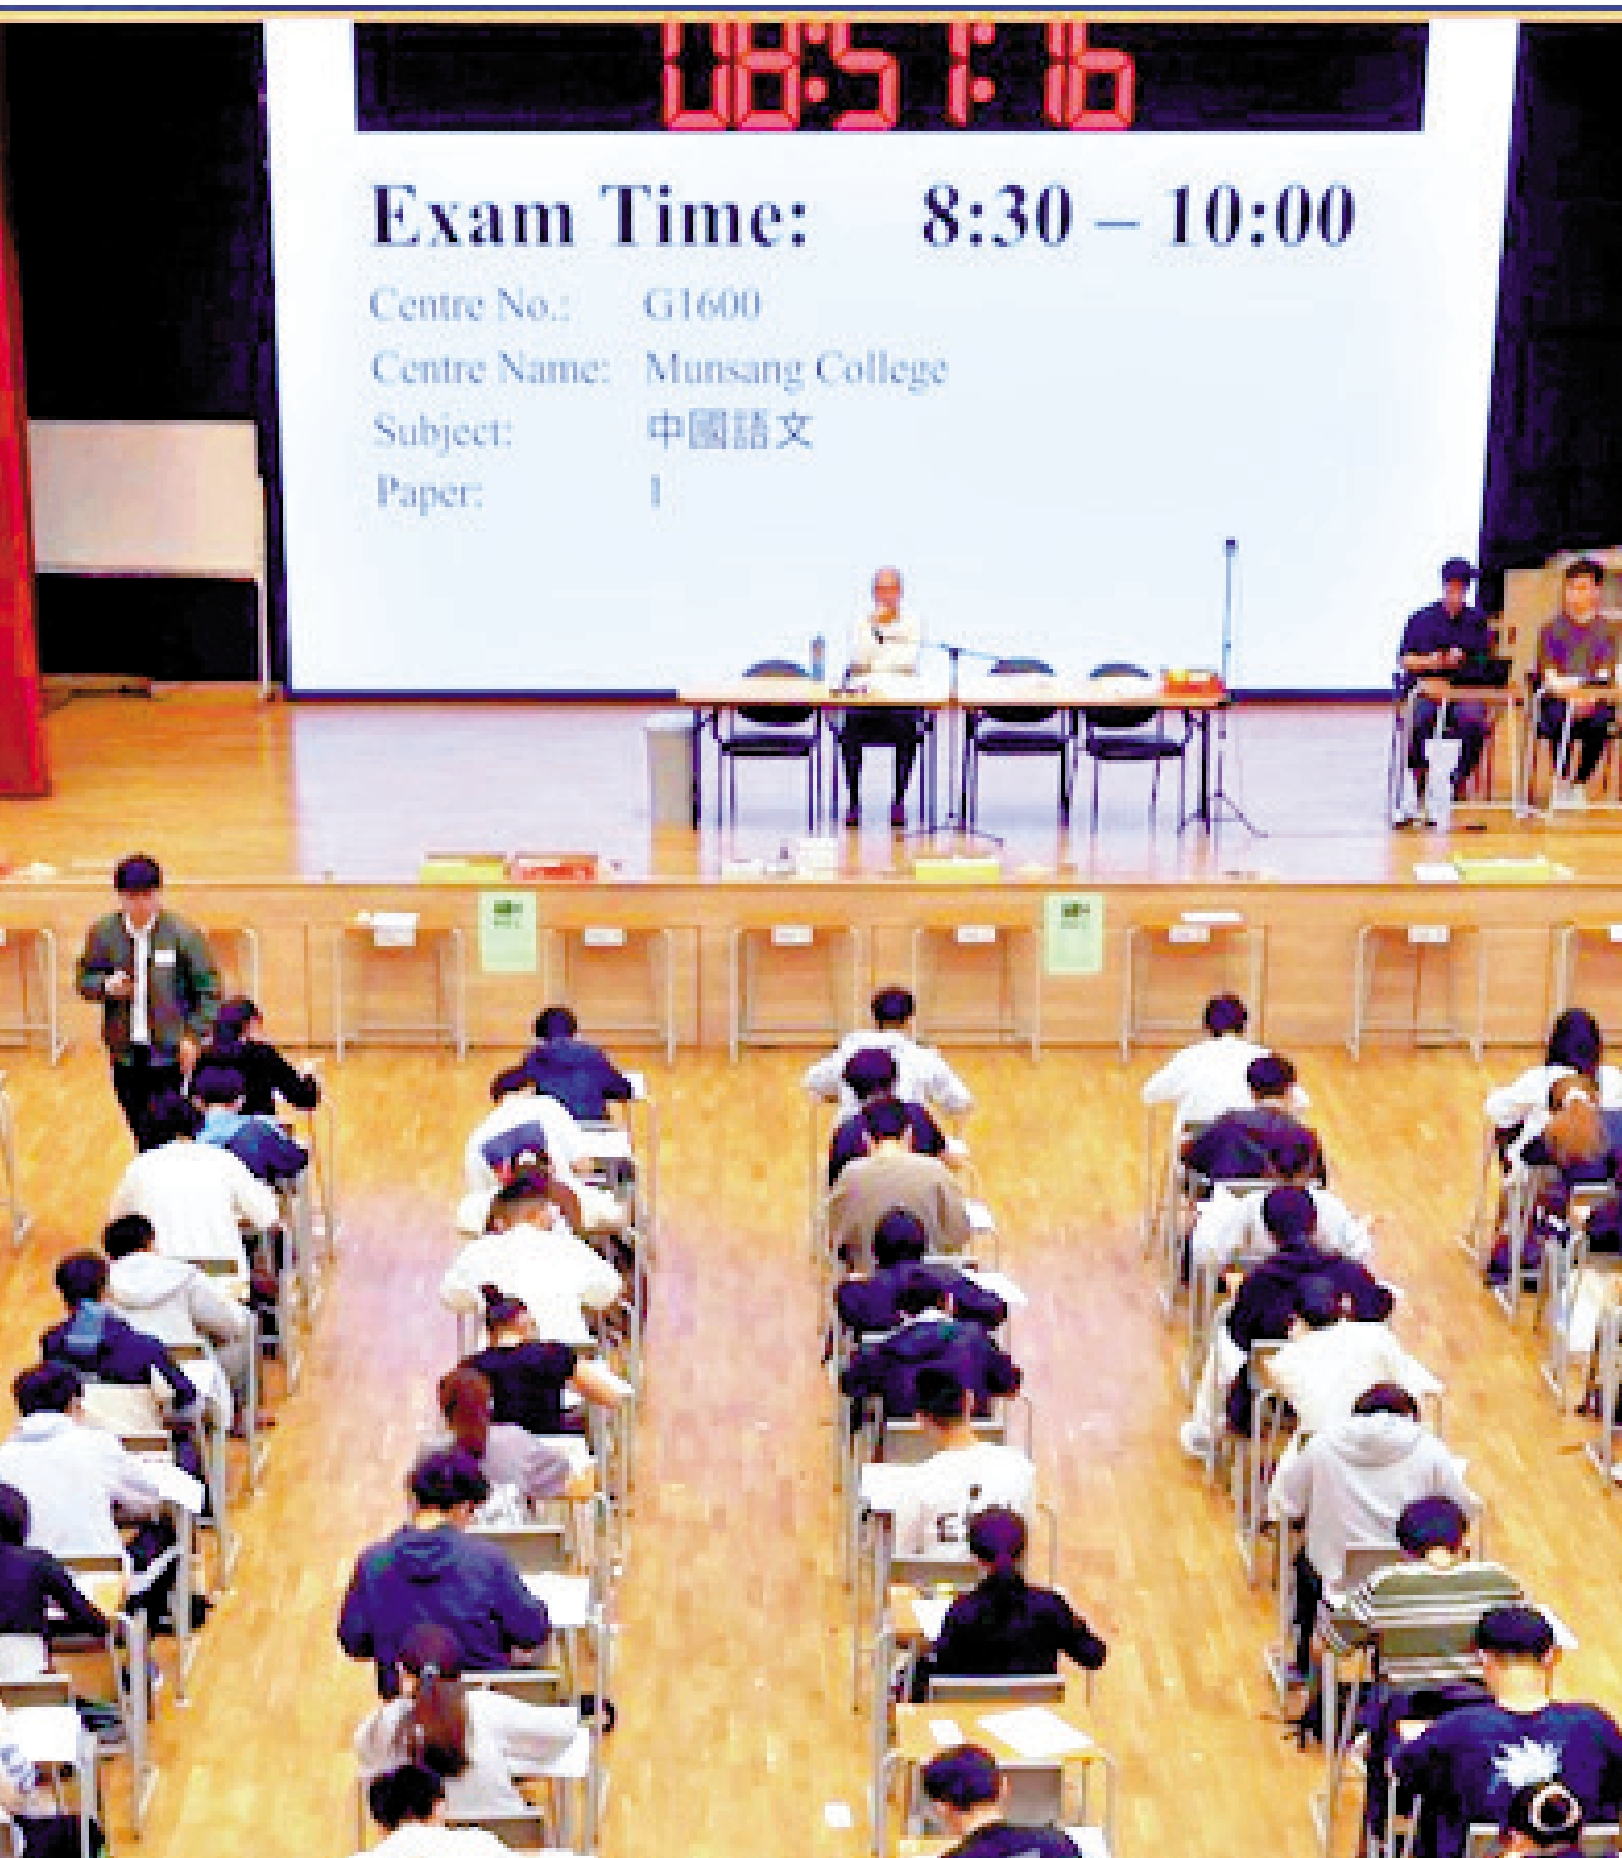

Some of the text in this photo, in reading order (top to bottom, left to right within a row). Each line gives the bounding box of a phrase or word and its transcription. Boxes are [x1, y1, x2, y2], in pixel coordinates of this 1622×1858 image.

[371, 184, 578, 248] Exam
[598, 184, 806, 248] Time:
[922, 183, 1073, 248] 8:30
[1169, 183, 1356, 248] 10:00
[369, 286, 761, 322] Centre No.: G1600
[372, 349, 949, 396] Centre Name: Munsang College
[372, 407, 815, 458] Subject: 中國語文
[377, 473, 484, 516] Paper:
